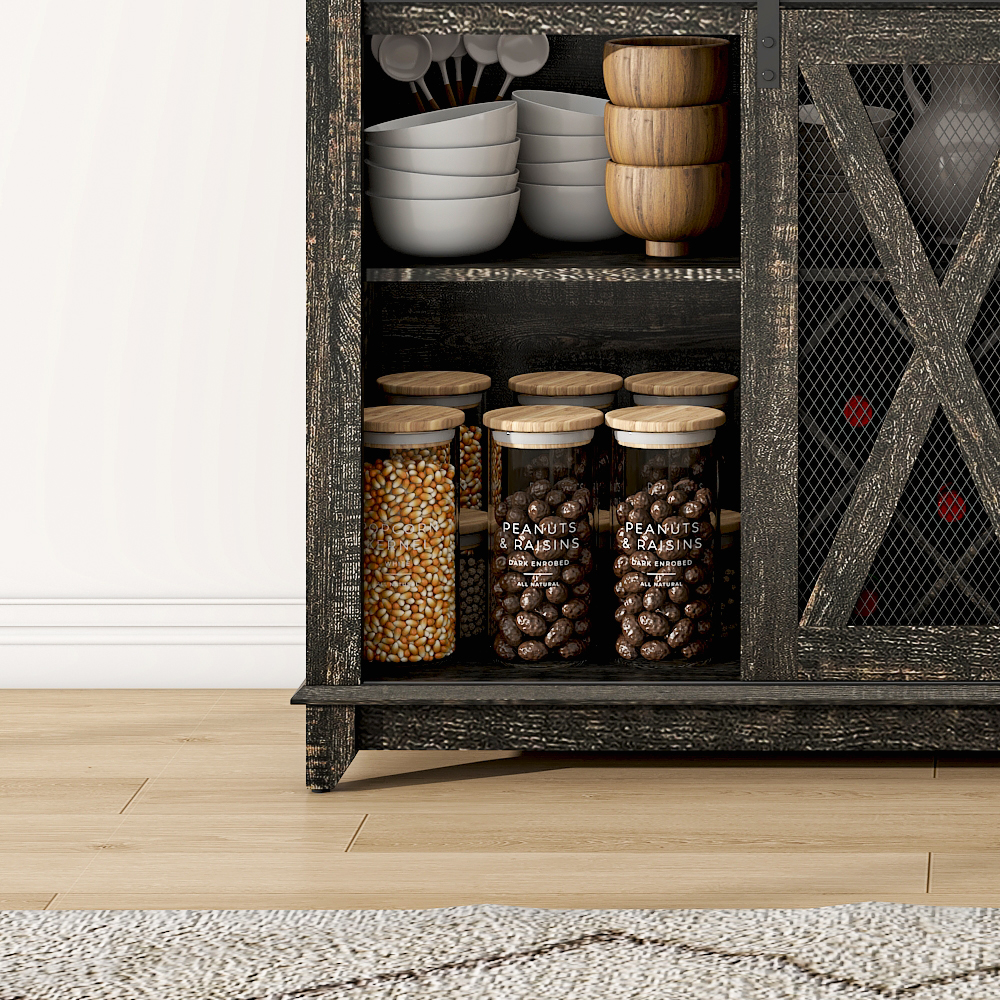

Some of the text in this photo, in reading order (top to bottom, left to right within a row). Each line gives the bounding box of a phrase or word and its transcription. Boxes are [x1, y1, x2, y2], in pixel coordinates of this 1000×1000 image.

[502, 521, 577, 536] PEANUTS
[625, 521, 700, 536] PEANUTS
[369, 538, 428, 551] KERNEL
[500, 538, 580, 551] & RAISINS
[622, 538, 703, 551] & RAISINS
[508, 559, 570, 567] DARK ENROBED
[631, 559, 693, 567] DARK ENROBED
